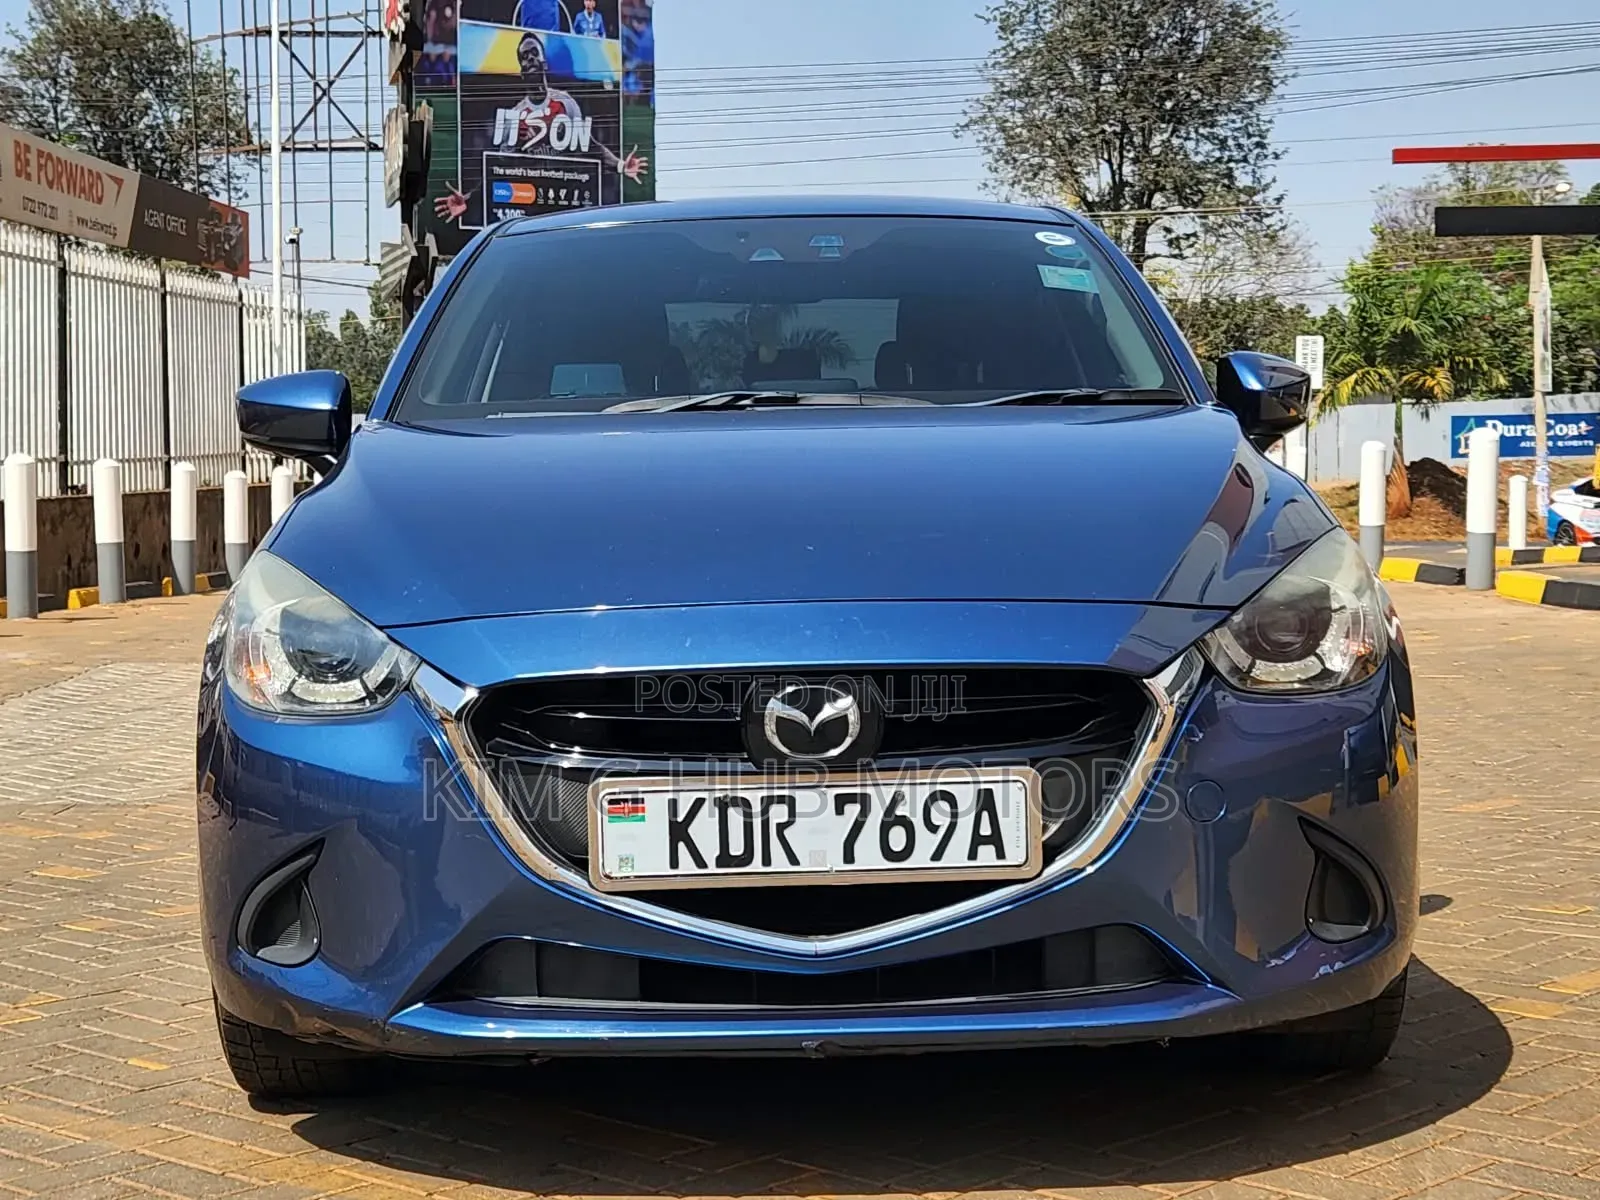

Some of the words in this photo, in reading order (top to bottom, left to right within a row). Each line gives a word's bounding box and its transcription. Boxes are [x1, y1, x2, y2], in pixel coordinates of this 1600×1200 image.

[549, 113, 593, 152] ON
[13, 139, 33, 182] BE
[36, 148, 105, 206] FORWARD
[493, 166, 504, 175] The
[505, 167, 526, 177] world's
[527, 168, 540, 178] best
[541, 169, 564, 179] football
[564, 172, 590, 183] package
[144, 208, 165, 231] AGENT
[165, 214, 187, 236] OFFICE
[667, 795, 800, 870] KDR
[834, 787, 1006, 865] 769A
